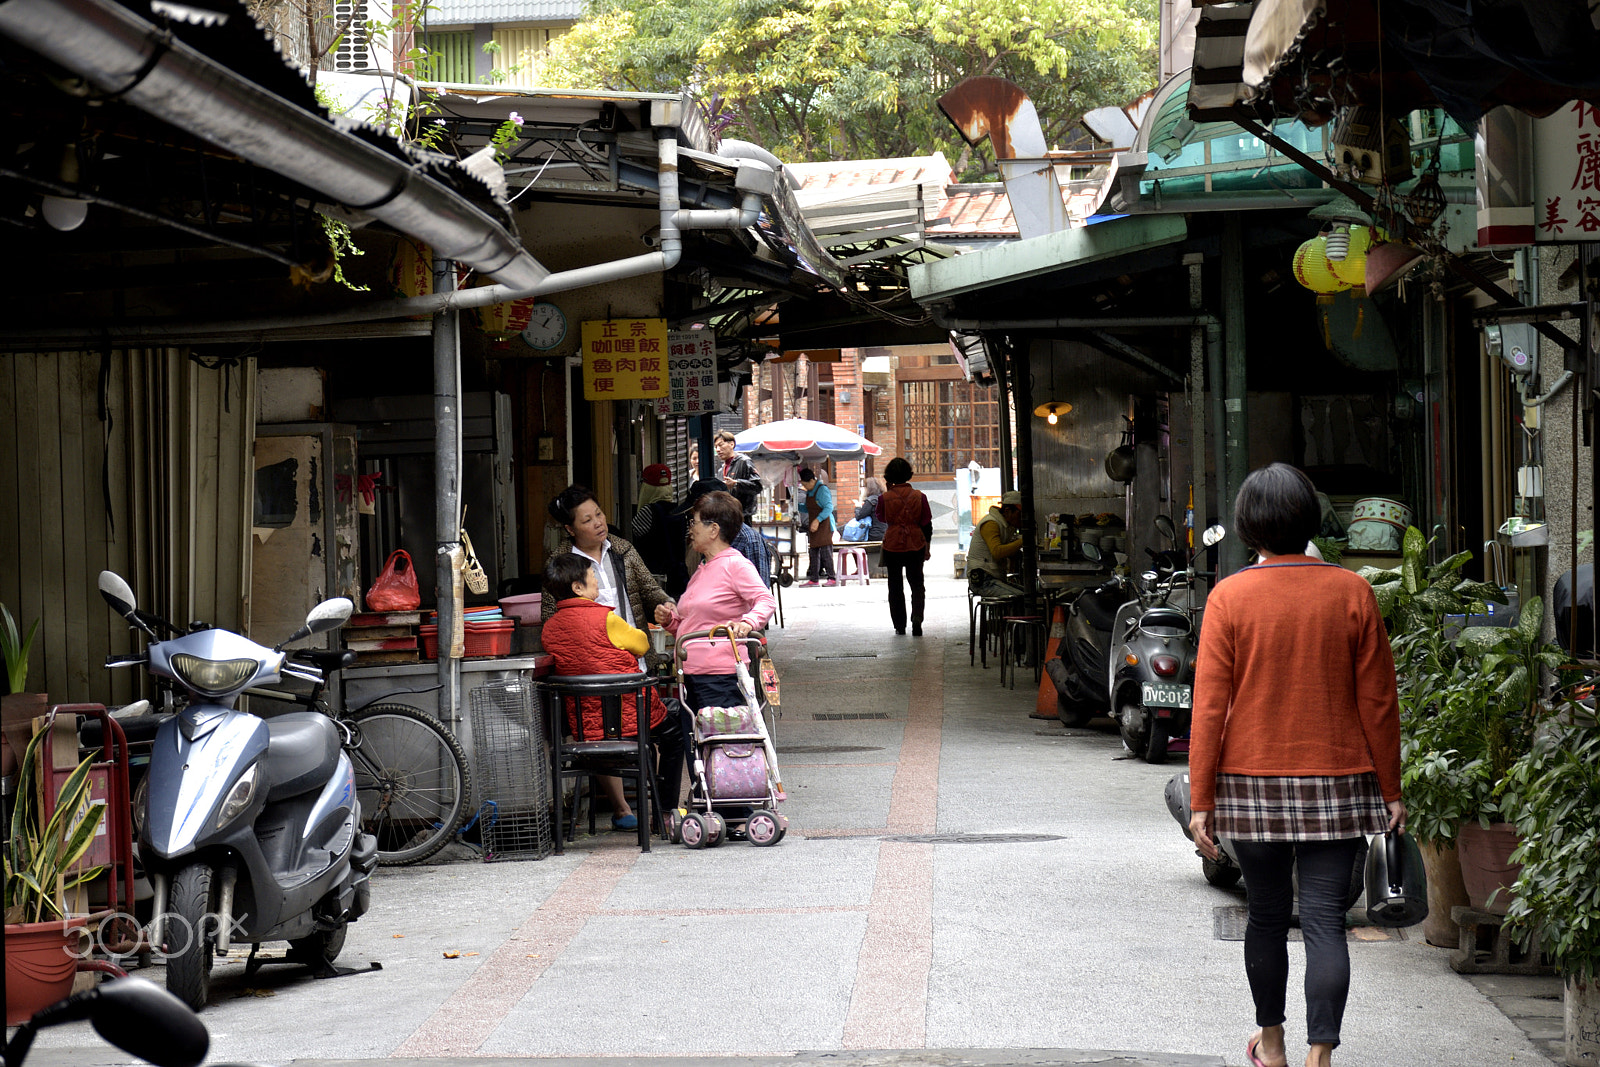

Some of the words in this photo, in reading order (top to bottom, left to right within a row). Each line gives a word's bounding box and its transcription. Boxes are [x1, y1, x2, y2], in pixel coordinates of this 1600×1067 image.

[602, 322, 647, 337] 正宗
[592, 338, 660, 353] 咖哩飯
[592, 358, 661, 373] 魯肉飯
[593, 376, 661, 392] 便當
[671, 377, 685, 412] 咖哩飯
[686, 376, 700, 411] 滷肉飯
[701, 375, 715, 410] 便當
